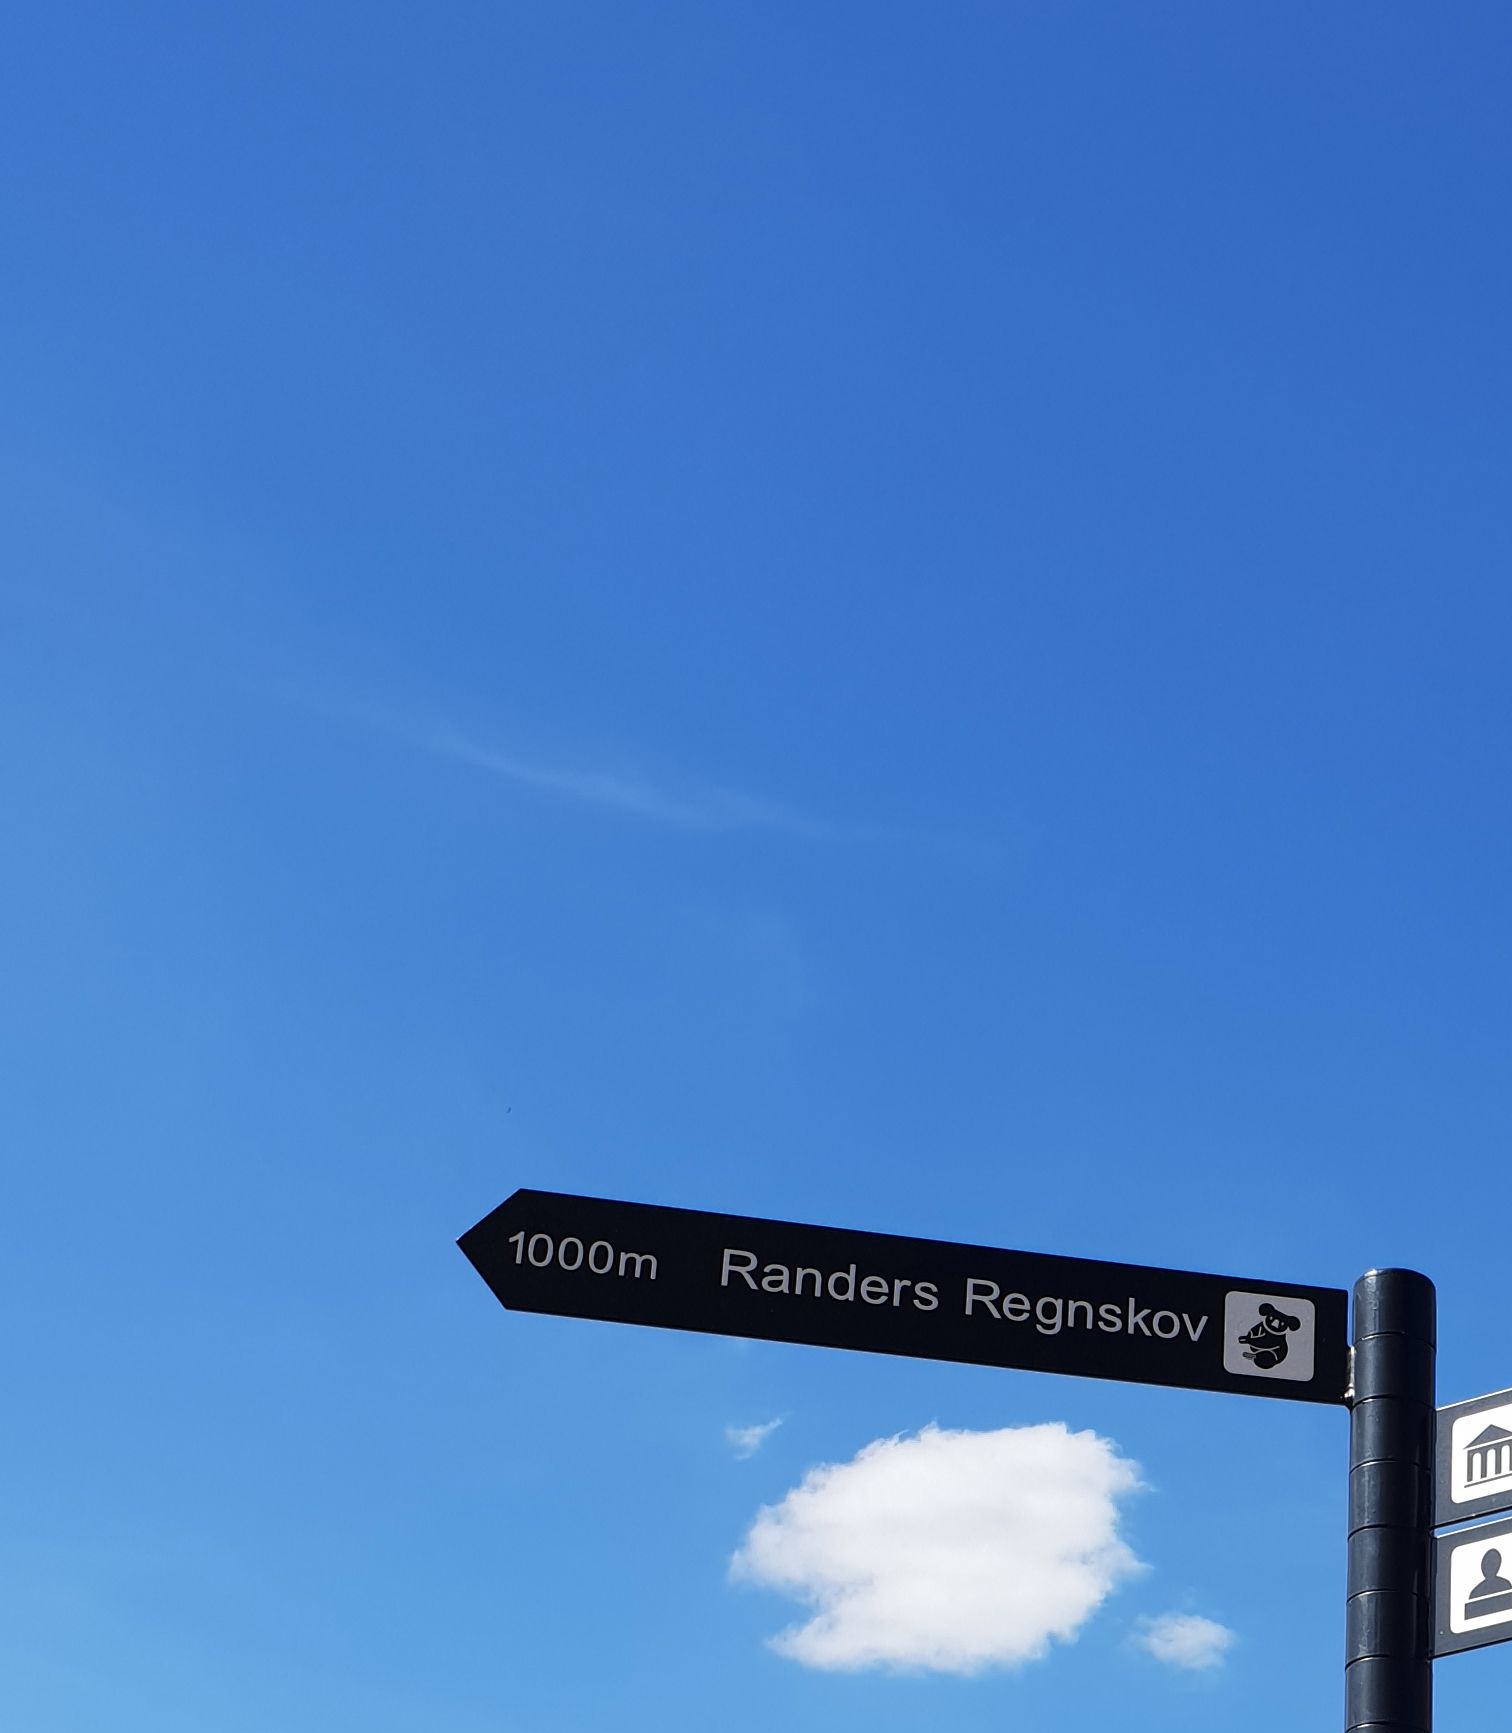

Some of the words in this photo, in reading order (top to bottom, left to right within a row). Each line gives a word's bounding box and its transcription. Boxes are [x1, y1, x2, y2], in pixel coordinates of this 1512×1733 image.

[508, 1231, 658, 1280] 1000m
[719, 1248, 940, 1312] Randers
[965, 1276, 1209, 1343] Regnskov
